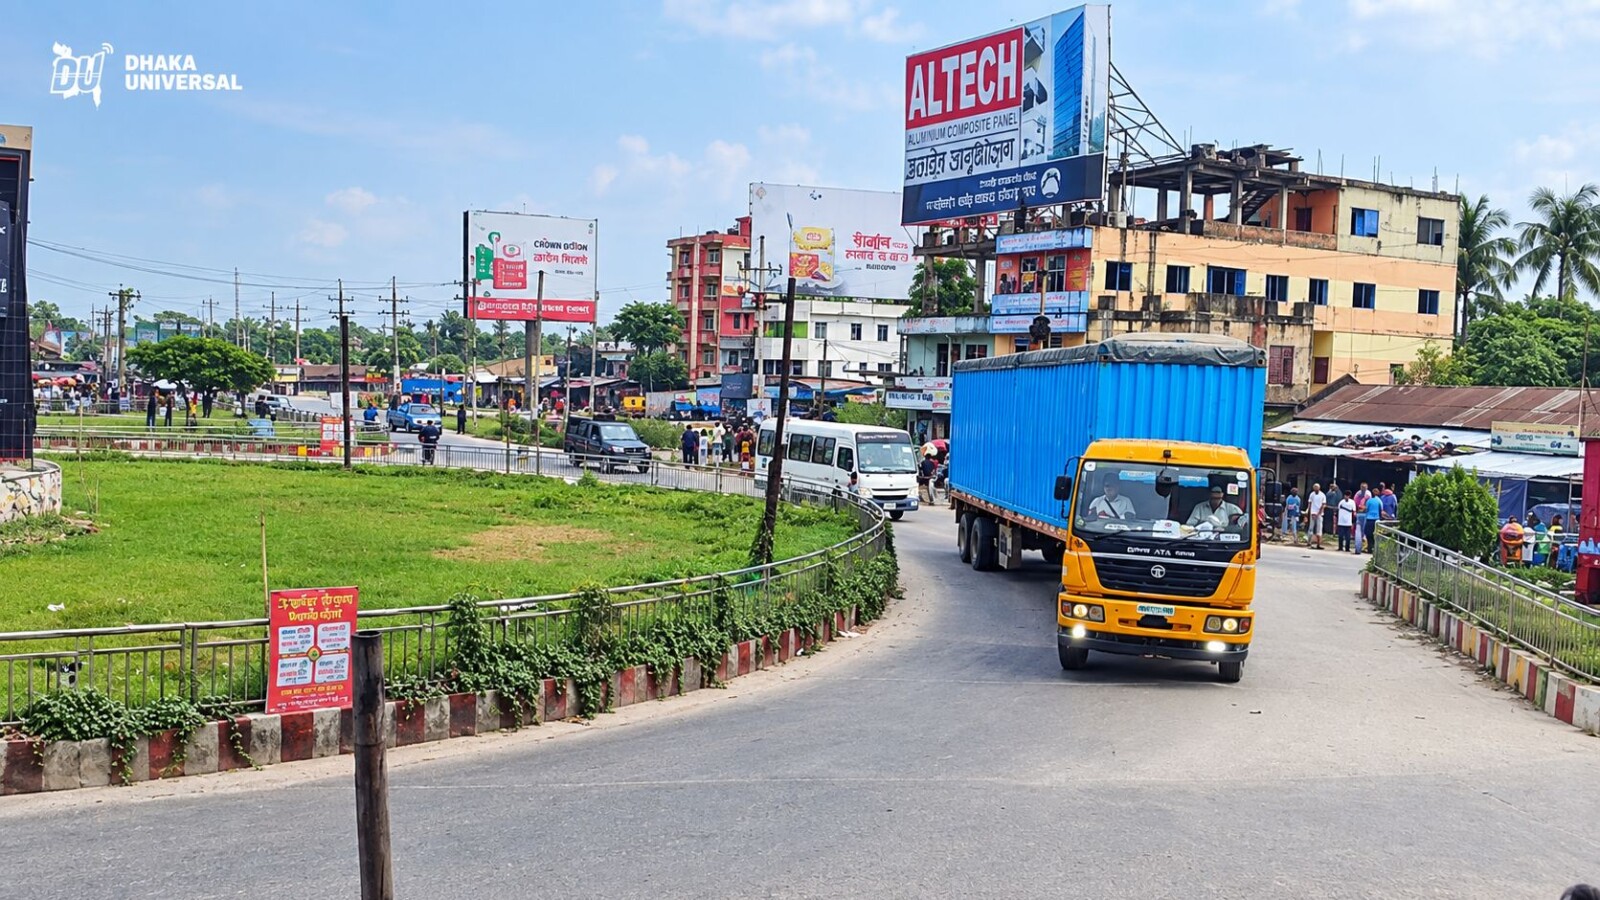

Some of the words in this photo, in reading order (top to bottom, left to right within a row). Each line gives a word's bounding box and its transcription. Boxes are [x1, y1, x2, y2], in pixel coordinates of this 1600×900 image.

[908, 39, 1018, 121] ALTECH
[908, 126, 946, 145] ALUMINIUM
[947, 117, 991, 138] COMPOSITE
[993, 112, 1018, 130] PANEL
[534, 240, 562, 250] CROWN
